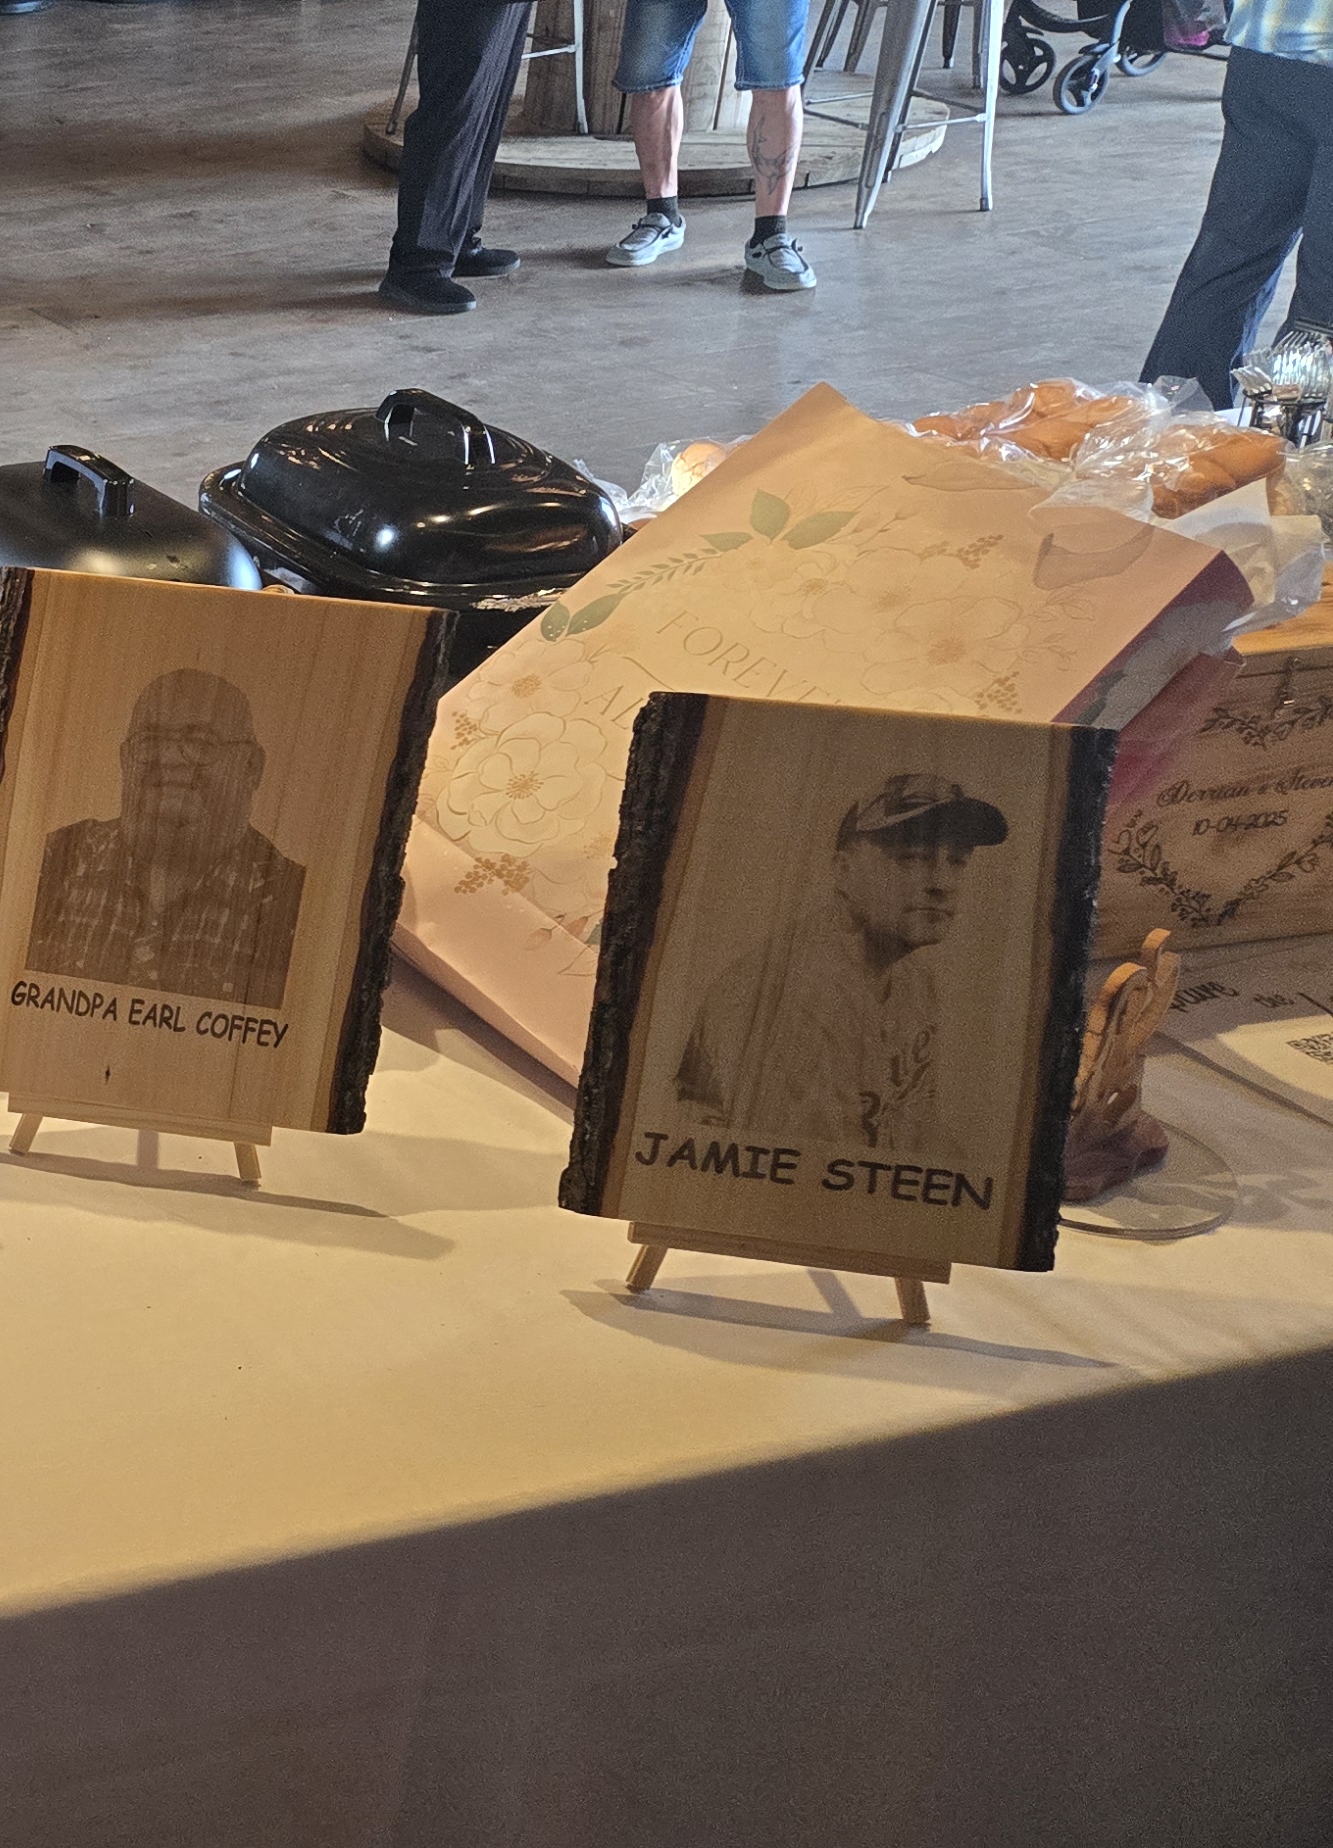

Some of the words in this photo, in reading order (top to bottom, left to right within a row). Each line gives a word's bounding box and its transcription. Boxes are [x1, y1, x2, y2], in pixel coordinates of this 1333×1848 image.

[11, 980, 118, 1022] GRANDPA
[128, 998, 186, 1033] EARL
[195, 1010, 289, 1049] COFFEY
[635, 1131, 802, 1185] JAMIE
[821, 1159, 995, 1211] STEEN
